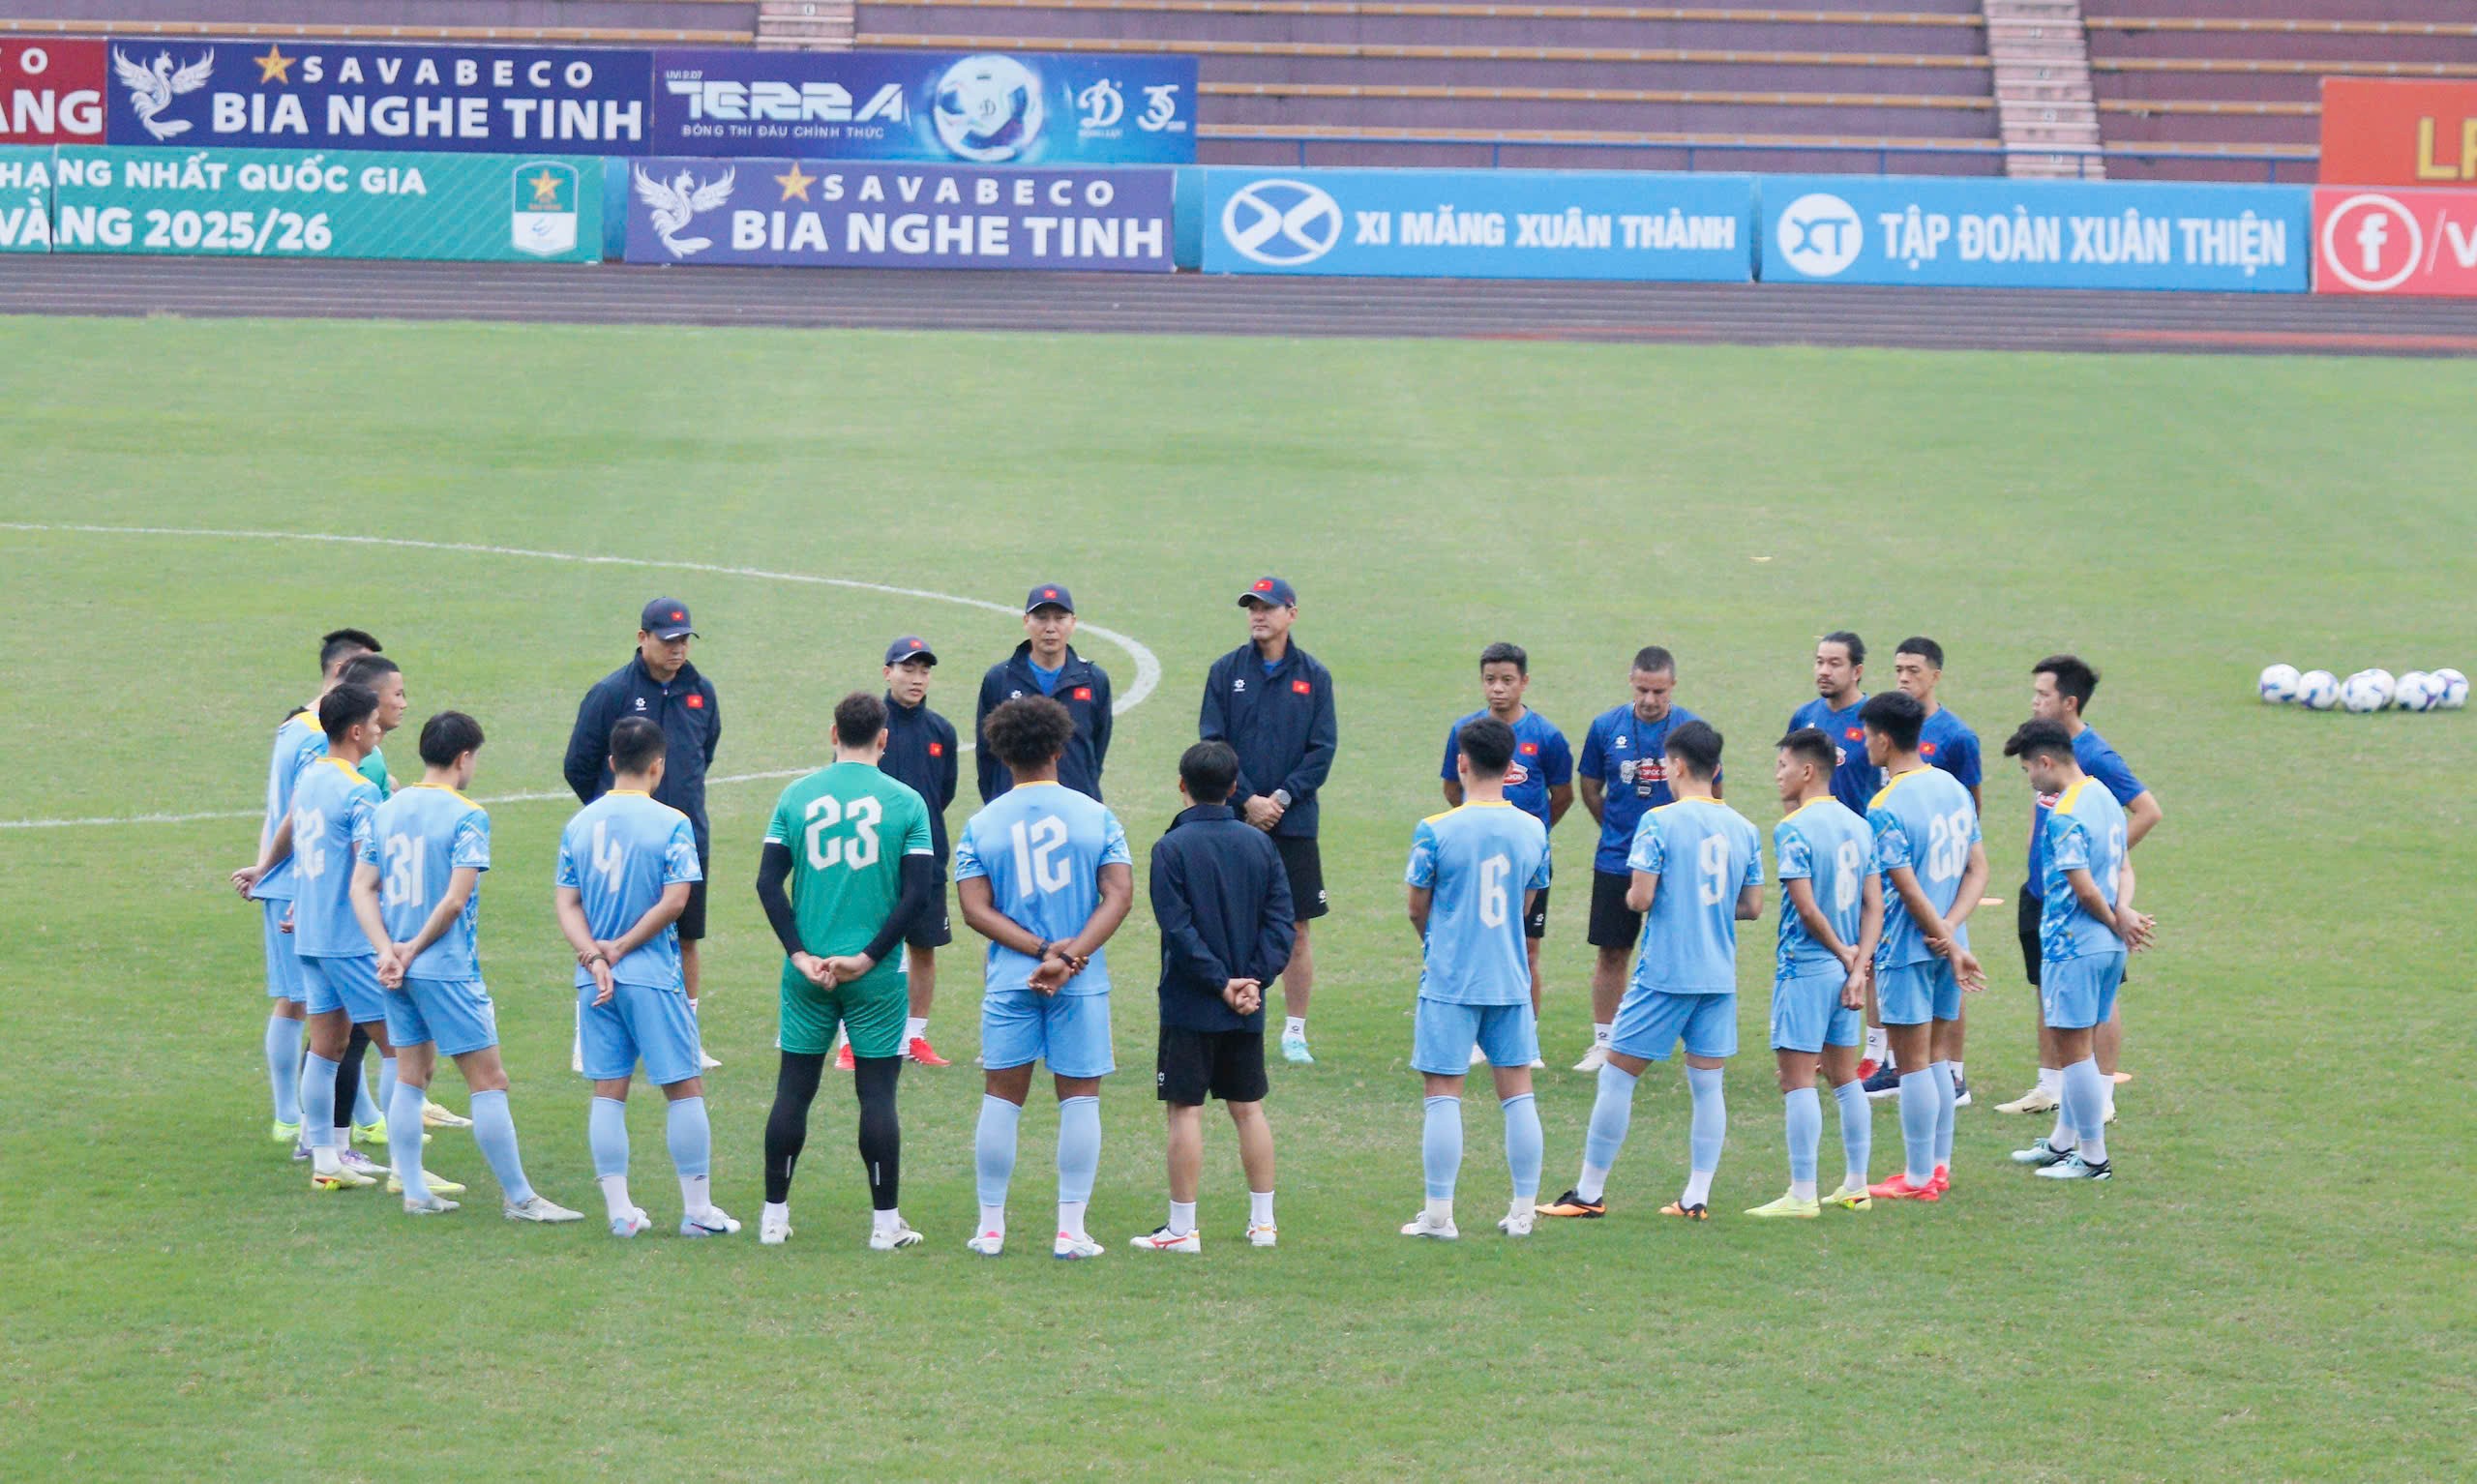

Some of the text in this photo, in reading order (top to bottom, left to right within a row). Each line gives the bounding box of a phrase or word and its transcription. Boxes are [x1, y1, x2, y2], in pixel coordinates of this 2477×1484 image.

[303, 56, 593, 88] SAVABECO
[0, 88, 103, 134] NG
[212, 93, 642, 140] BIA NGHE TINH
[666, 80, 904, 122] TERRA
[682, 124, 724, 136] BÓNG
[730, 124, 752, 136] THI
[125, 152, 228, 191] NHẤT
[239, 155, 349, 193] QUỐC
[360, 166, 427, 194] GIA
[822, 174, 1115, 206] SAVABECO
[144, 207, 332, 254] 2025/26
[732, 210, 1163, 257] BIA NGHE TINH
[1355, 204, 1736, 250] XI MĂNG XUÂN THÀNH
[1879, 204, 2286, 278] TẬP ĐOÀN XUÂN THIỆN
[804, 794, 882, 871] 23
[1927, 807, 1974, 883] 28
[384, 832, 427, 908] 31
[591, 819, 624, 894] 4
[1009, 815, 1072, 899] 12
[1699, 833, 1729, 906] 9
[1835, 839, 1860, 912] 8
[1478, 852, 1512, 930] 6
